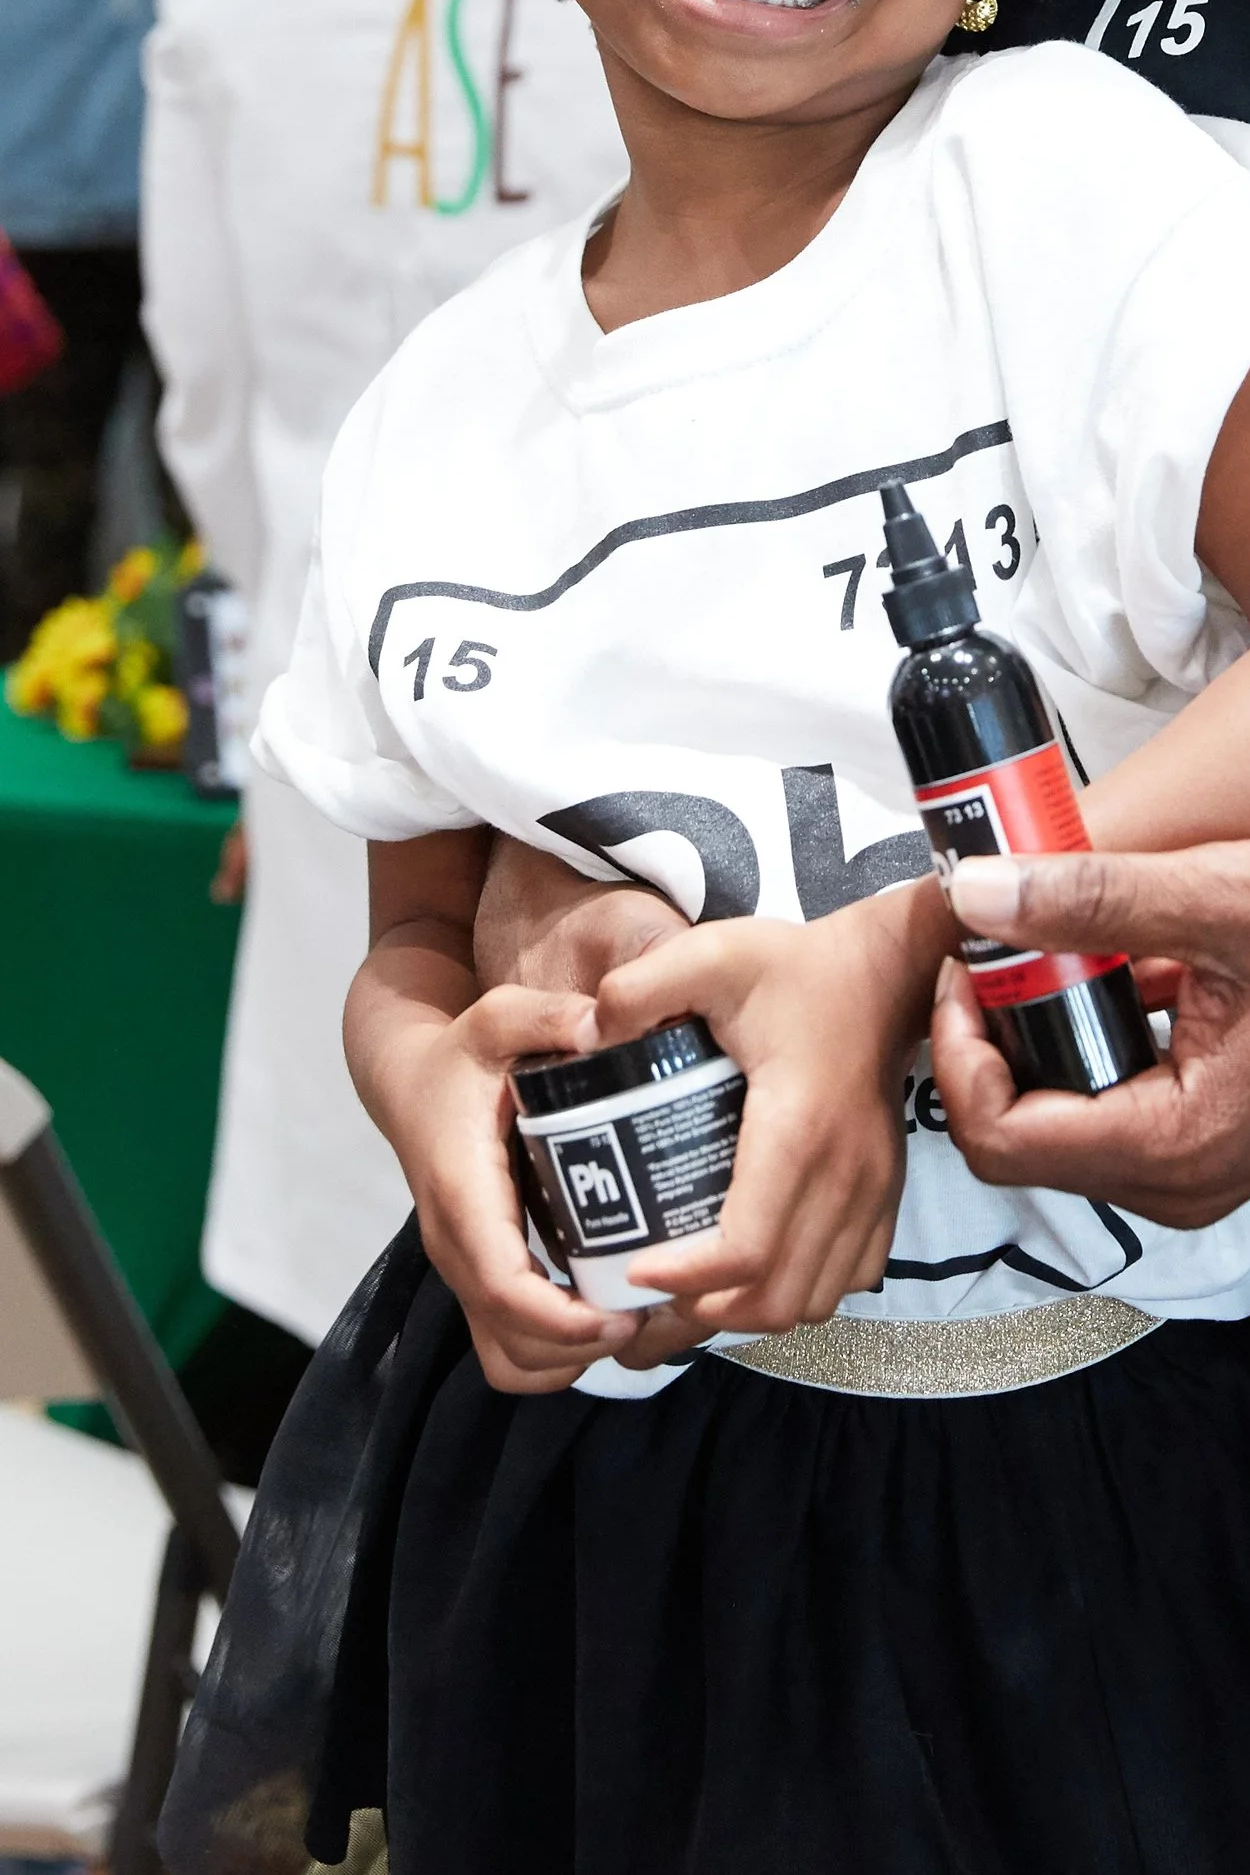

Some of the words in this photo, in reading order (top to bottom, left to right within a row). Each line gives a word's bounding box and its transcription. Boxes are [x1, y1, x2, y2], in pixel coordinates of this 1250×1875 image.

[823, 546, 893, 631] 7
[943, 503, 1021, 591] 13
[402, 636, 499, 702] 15
[963, 800, 985, 821] 13
[568, 1160, 621, 1207] Ph
